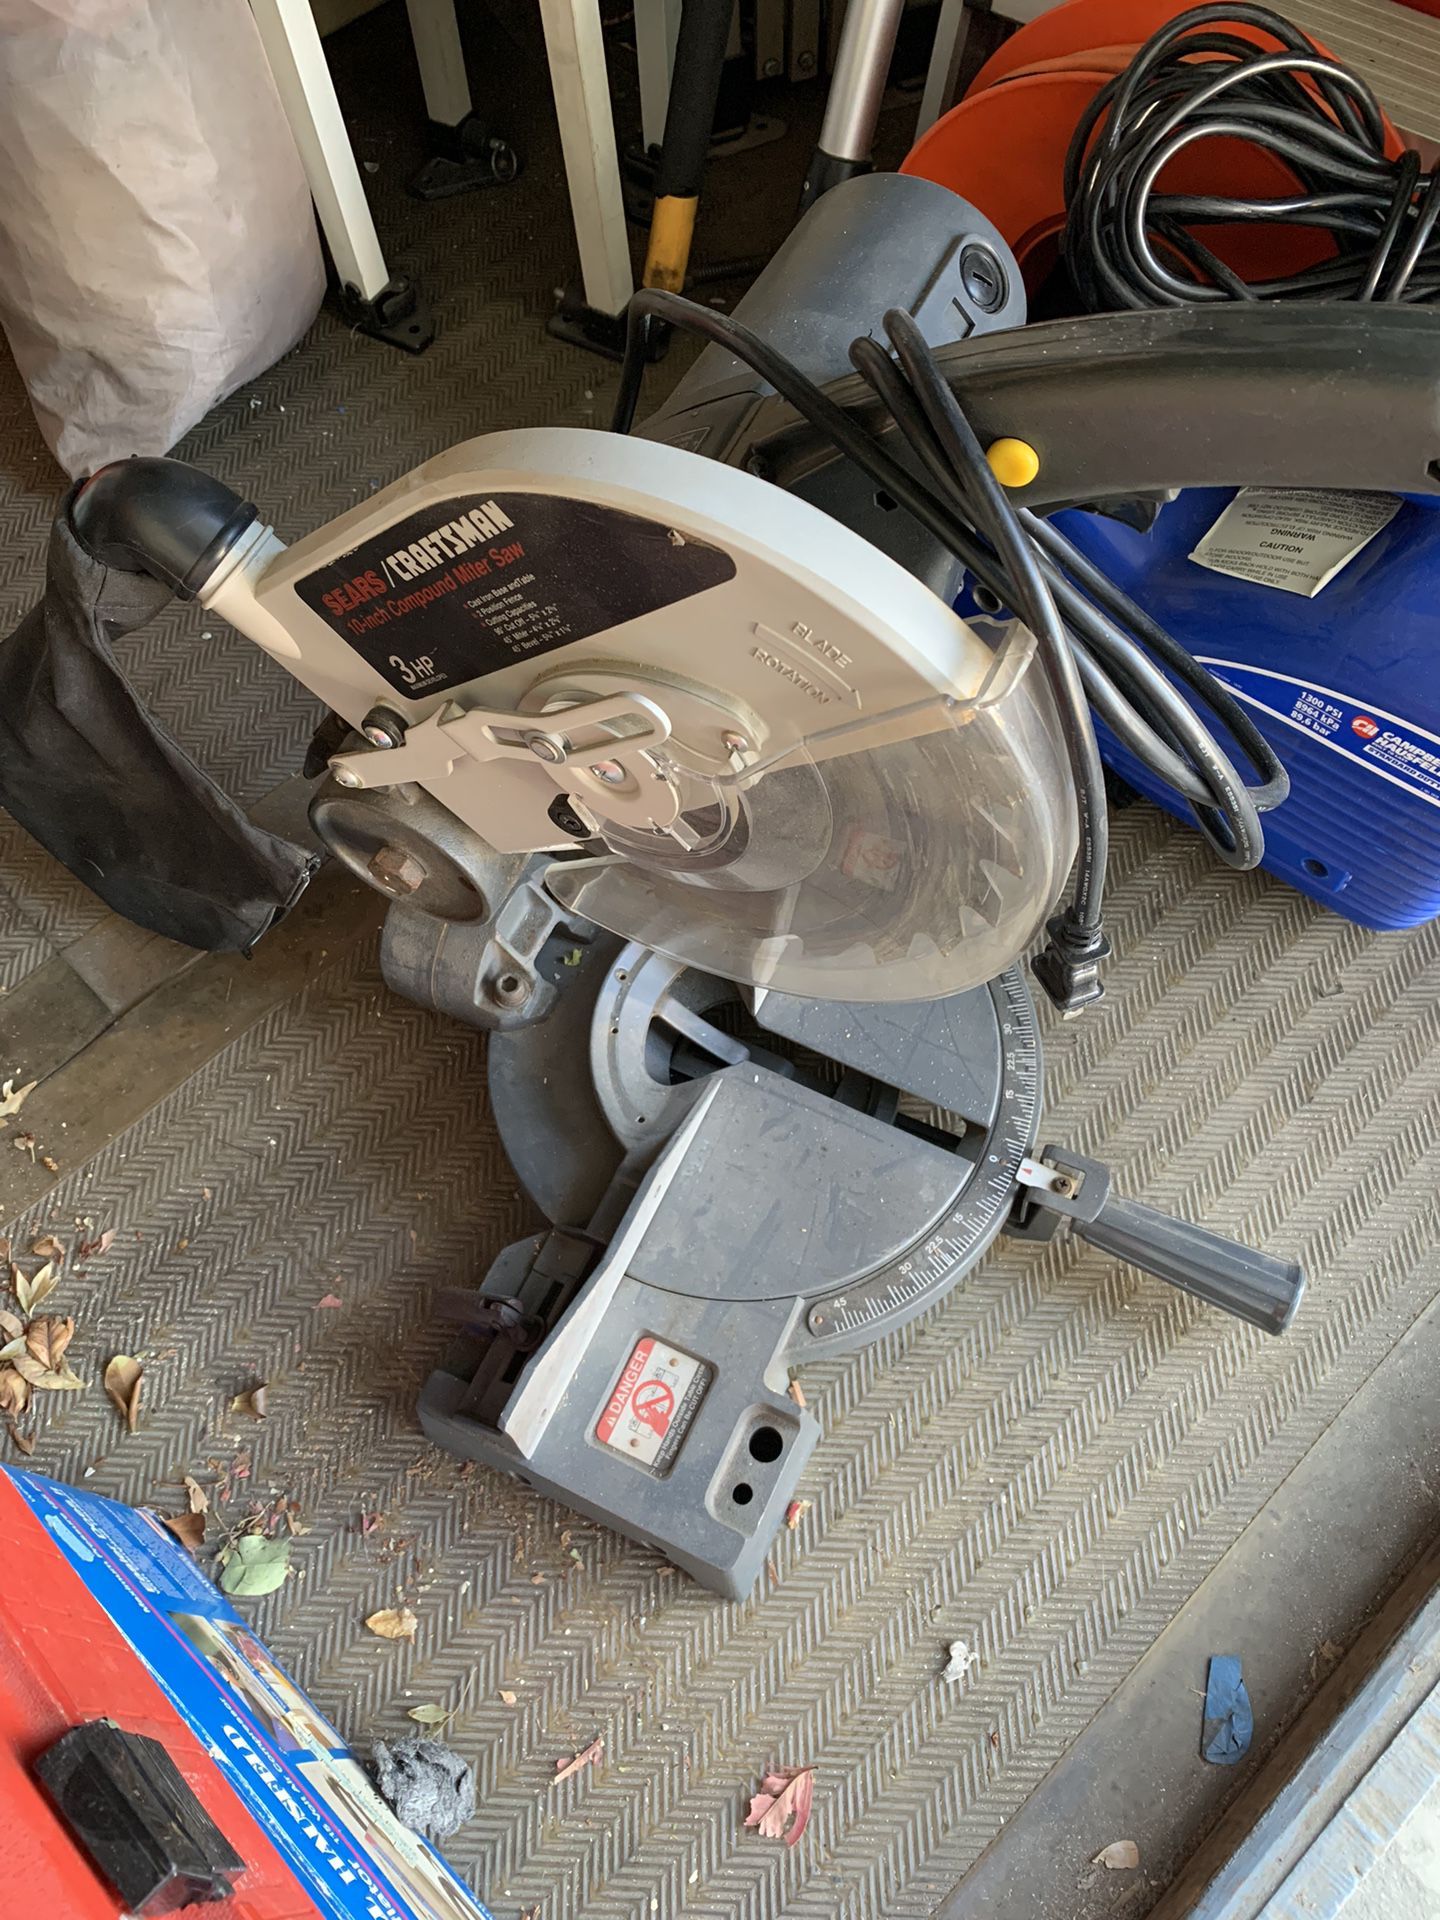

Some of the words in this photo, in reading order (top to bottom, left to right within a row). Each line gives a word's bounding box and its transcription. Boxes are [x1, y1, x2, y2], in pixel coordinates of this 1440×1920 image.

[1259, 541, 1304, 554] CAUTION
[1270, 528, 1315, 540] WARNING
[322, 571, 385, 617] SEARS
[347, 604, 394, 636] 10-inch
[385, 572, 457, 616] Compound
[451, 555, 492, 584] Miter
[488, 539, 525, 566] Saw
[480, 600, 505, 614] Position
[502, 592, 523, 605] Fence
[791, 620, 853, 668] BLADE
[387, 654, 415, 681] 3
[409, 656, 435, 680] HP
[752, 646, 832, 704] ROTATION
[1295, 701, 1320, 717] 8964
[1320, 715, 1340, 729] kPa
[1301, 691, 1324, 709] 1300
[1325, 705, 1343, 719] PSI
[1312, 722, 1330, 737] bar
[1369, 747, 1416, 774] STANDARD
[1375, 737, 1440, 777] HAUSFEL
[1004, 1023, 1012, 1035] 30
[1006, 1052, 1015, 1071] 22.5
[989, 1154, 998, 1163] 0
[952, 1213, 964, 1224] 15
[925, 1235, 944, 1254] 22.5
[899, 1262, 912, 1274] 30
[833, 1298, 848, 1309] 45
[608, 1350, 648, 1414] DANGER
[653, 1449, 665, 1466] Keep
[662, 1428, 676, 1449] Hands
[684, 1383, 696, 1400] Table
[665, 1433, 681, 1459] Fingers
[677, 1419, 687, 1434] Can
[683, 1409, 692, 1419] Be
[688, 1394, 699, 1409] CUT
[104, 1560, 150, 1613] Maximum
[219, 1697, 283, 1773] Compressor
[285, 1778, 300, 1792] Air
[223, 1724, 356, 1885] HAUSFELD
[300, 1800, 322, 1823] Volt
[321, 1823, 340, 1844] 115
